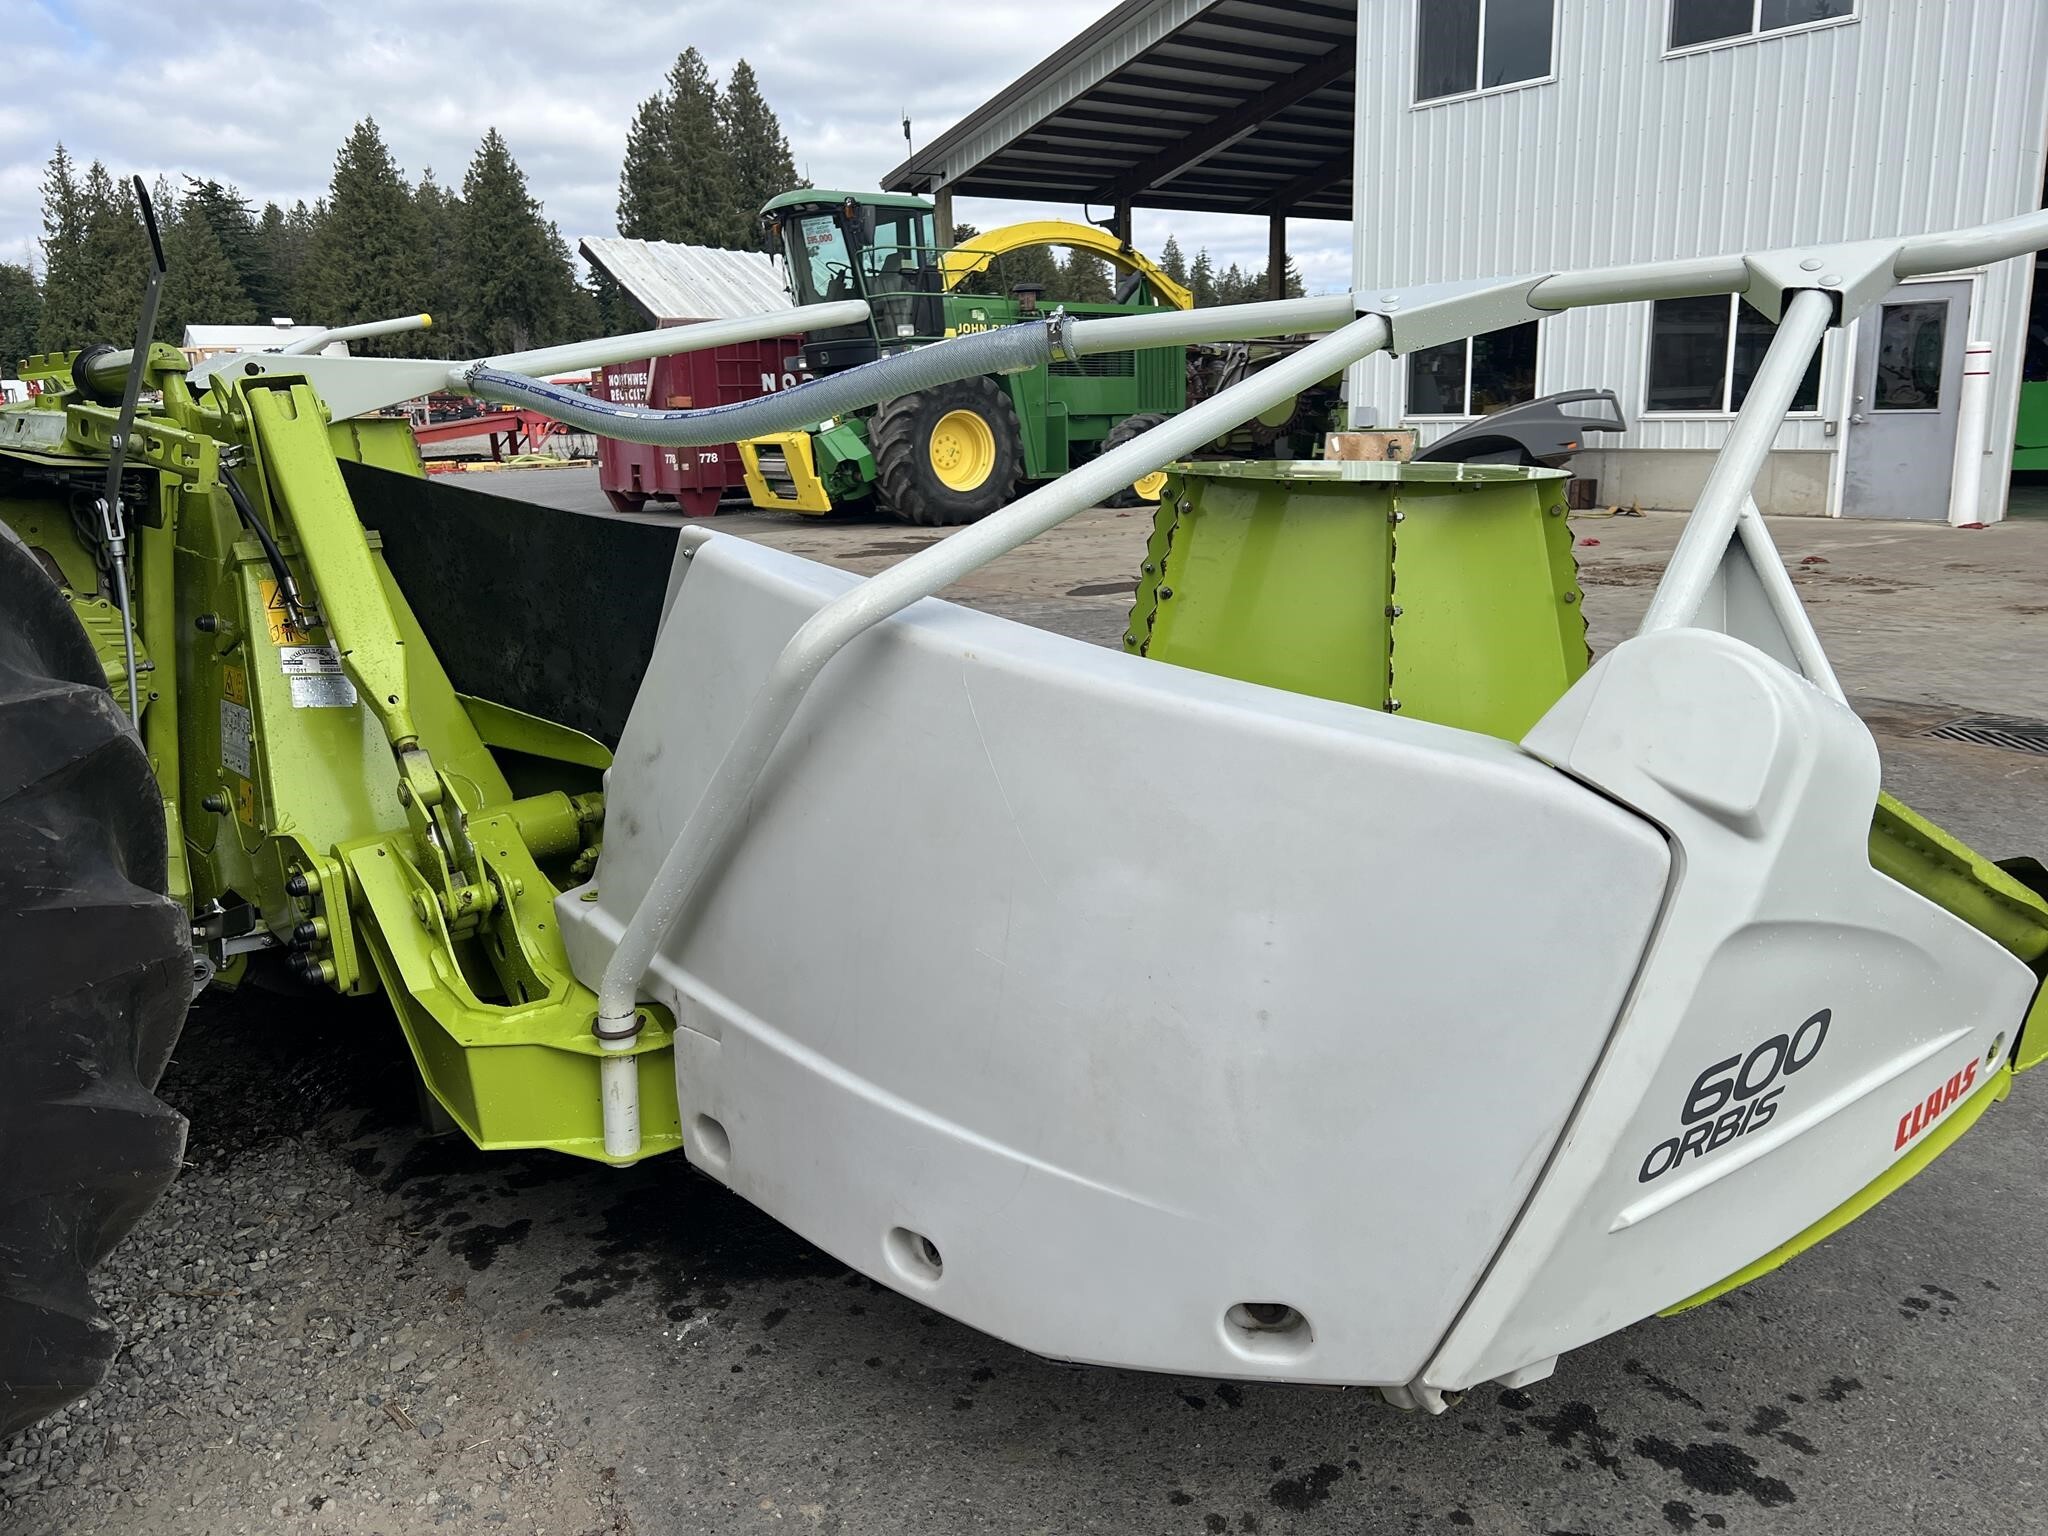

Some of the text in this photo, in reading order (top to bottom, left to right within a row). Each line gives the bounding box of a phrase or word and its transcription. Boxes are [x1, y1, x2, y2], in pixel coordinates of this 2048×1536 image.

[958, 323, 987, 333] JOHN
[608, 372, 651, 386] NORTHWES
[699, 452, 719, 464] 778
[1681, 1008, 1832, 1126] 600
[1894, 1057, 1980, 1152] CLAAS
[1638, 1085, 1786, 1183] ORBIS
